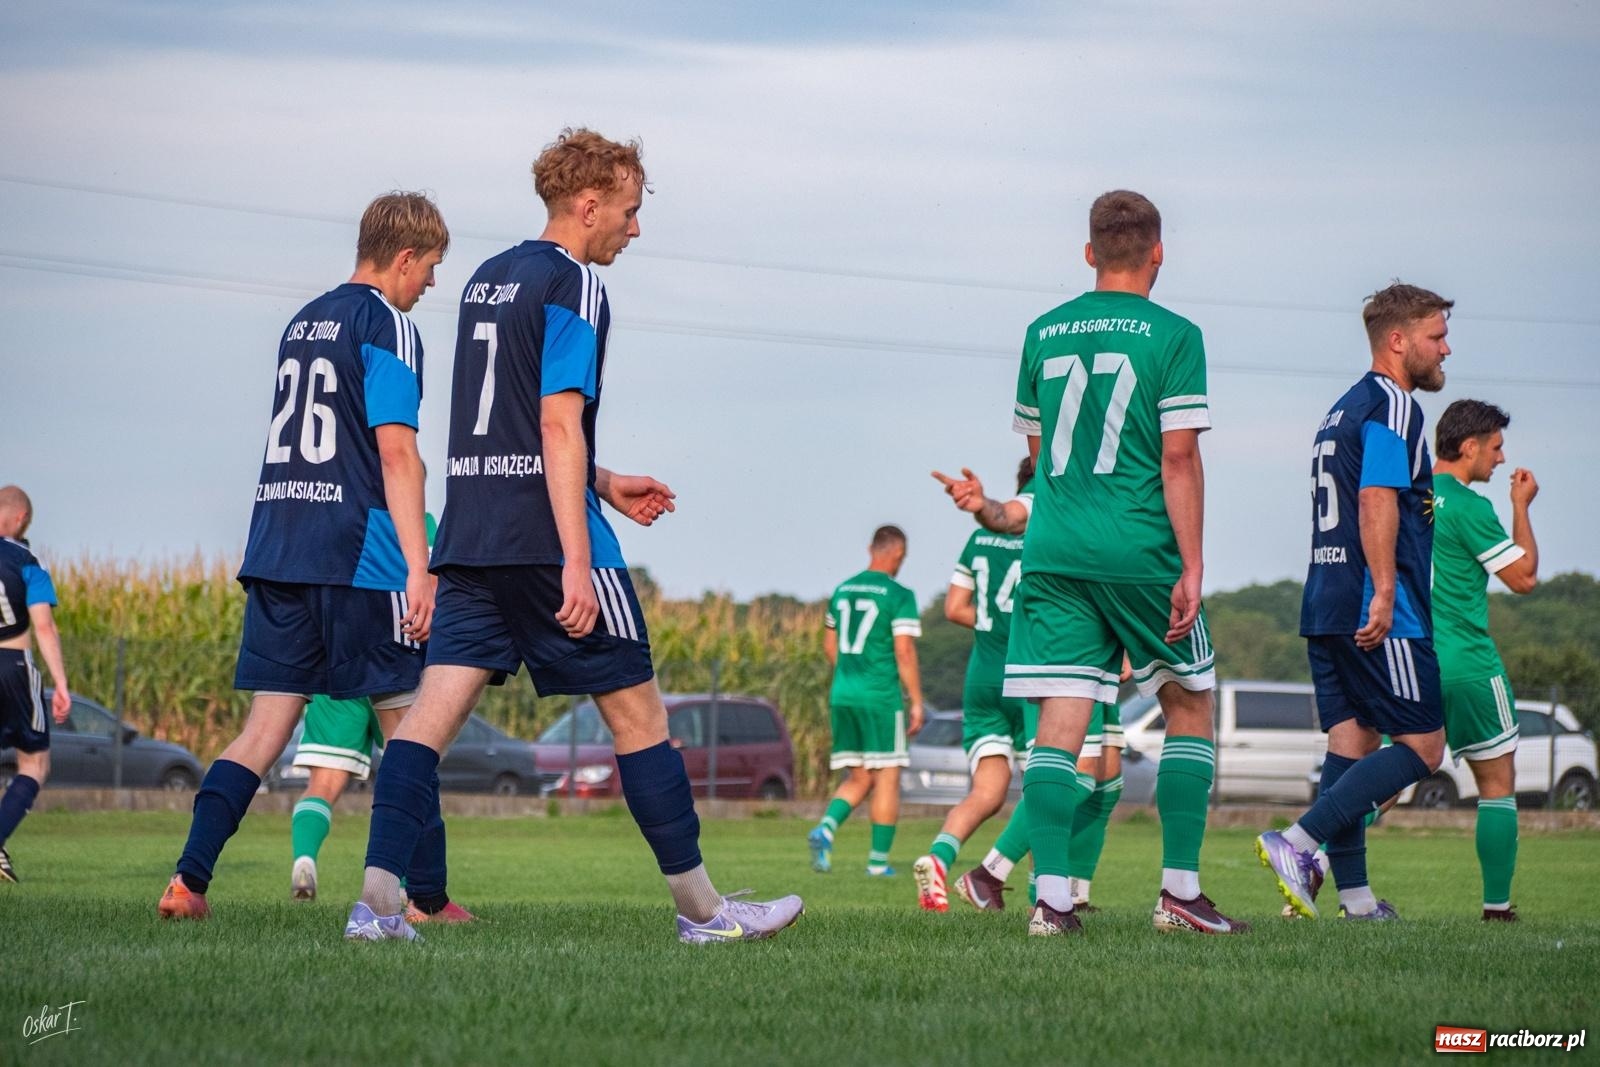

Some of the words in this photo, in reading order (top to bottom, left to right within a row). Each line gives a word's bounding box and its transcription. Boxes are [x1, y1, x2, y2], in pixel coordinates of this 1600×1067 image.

[464, 282, 490, 304] LKS
[287, 320, 308, 341] LKS
[1039, 318, 1152, 341] WWW.BSGORZYCE.PL
[472, 321, 498, 436] 7
[265, 357, 338, 465] 26
[1042, 352, 1138, 478] 77
[483, 453, 544, 478] KSIĄŻĘCA
[836, 598, 879, 655] 17
